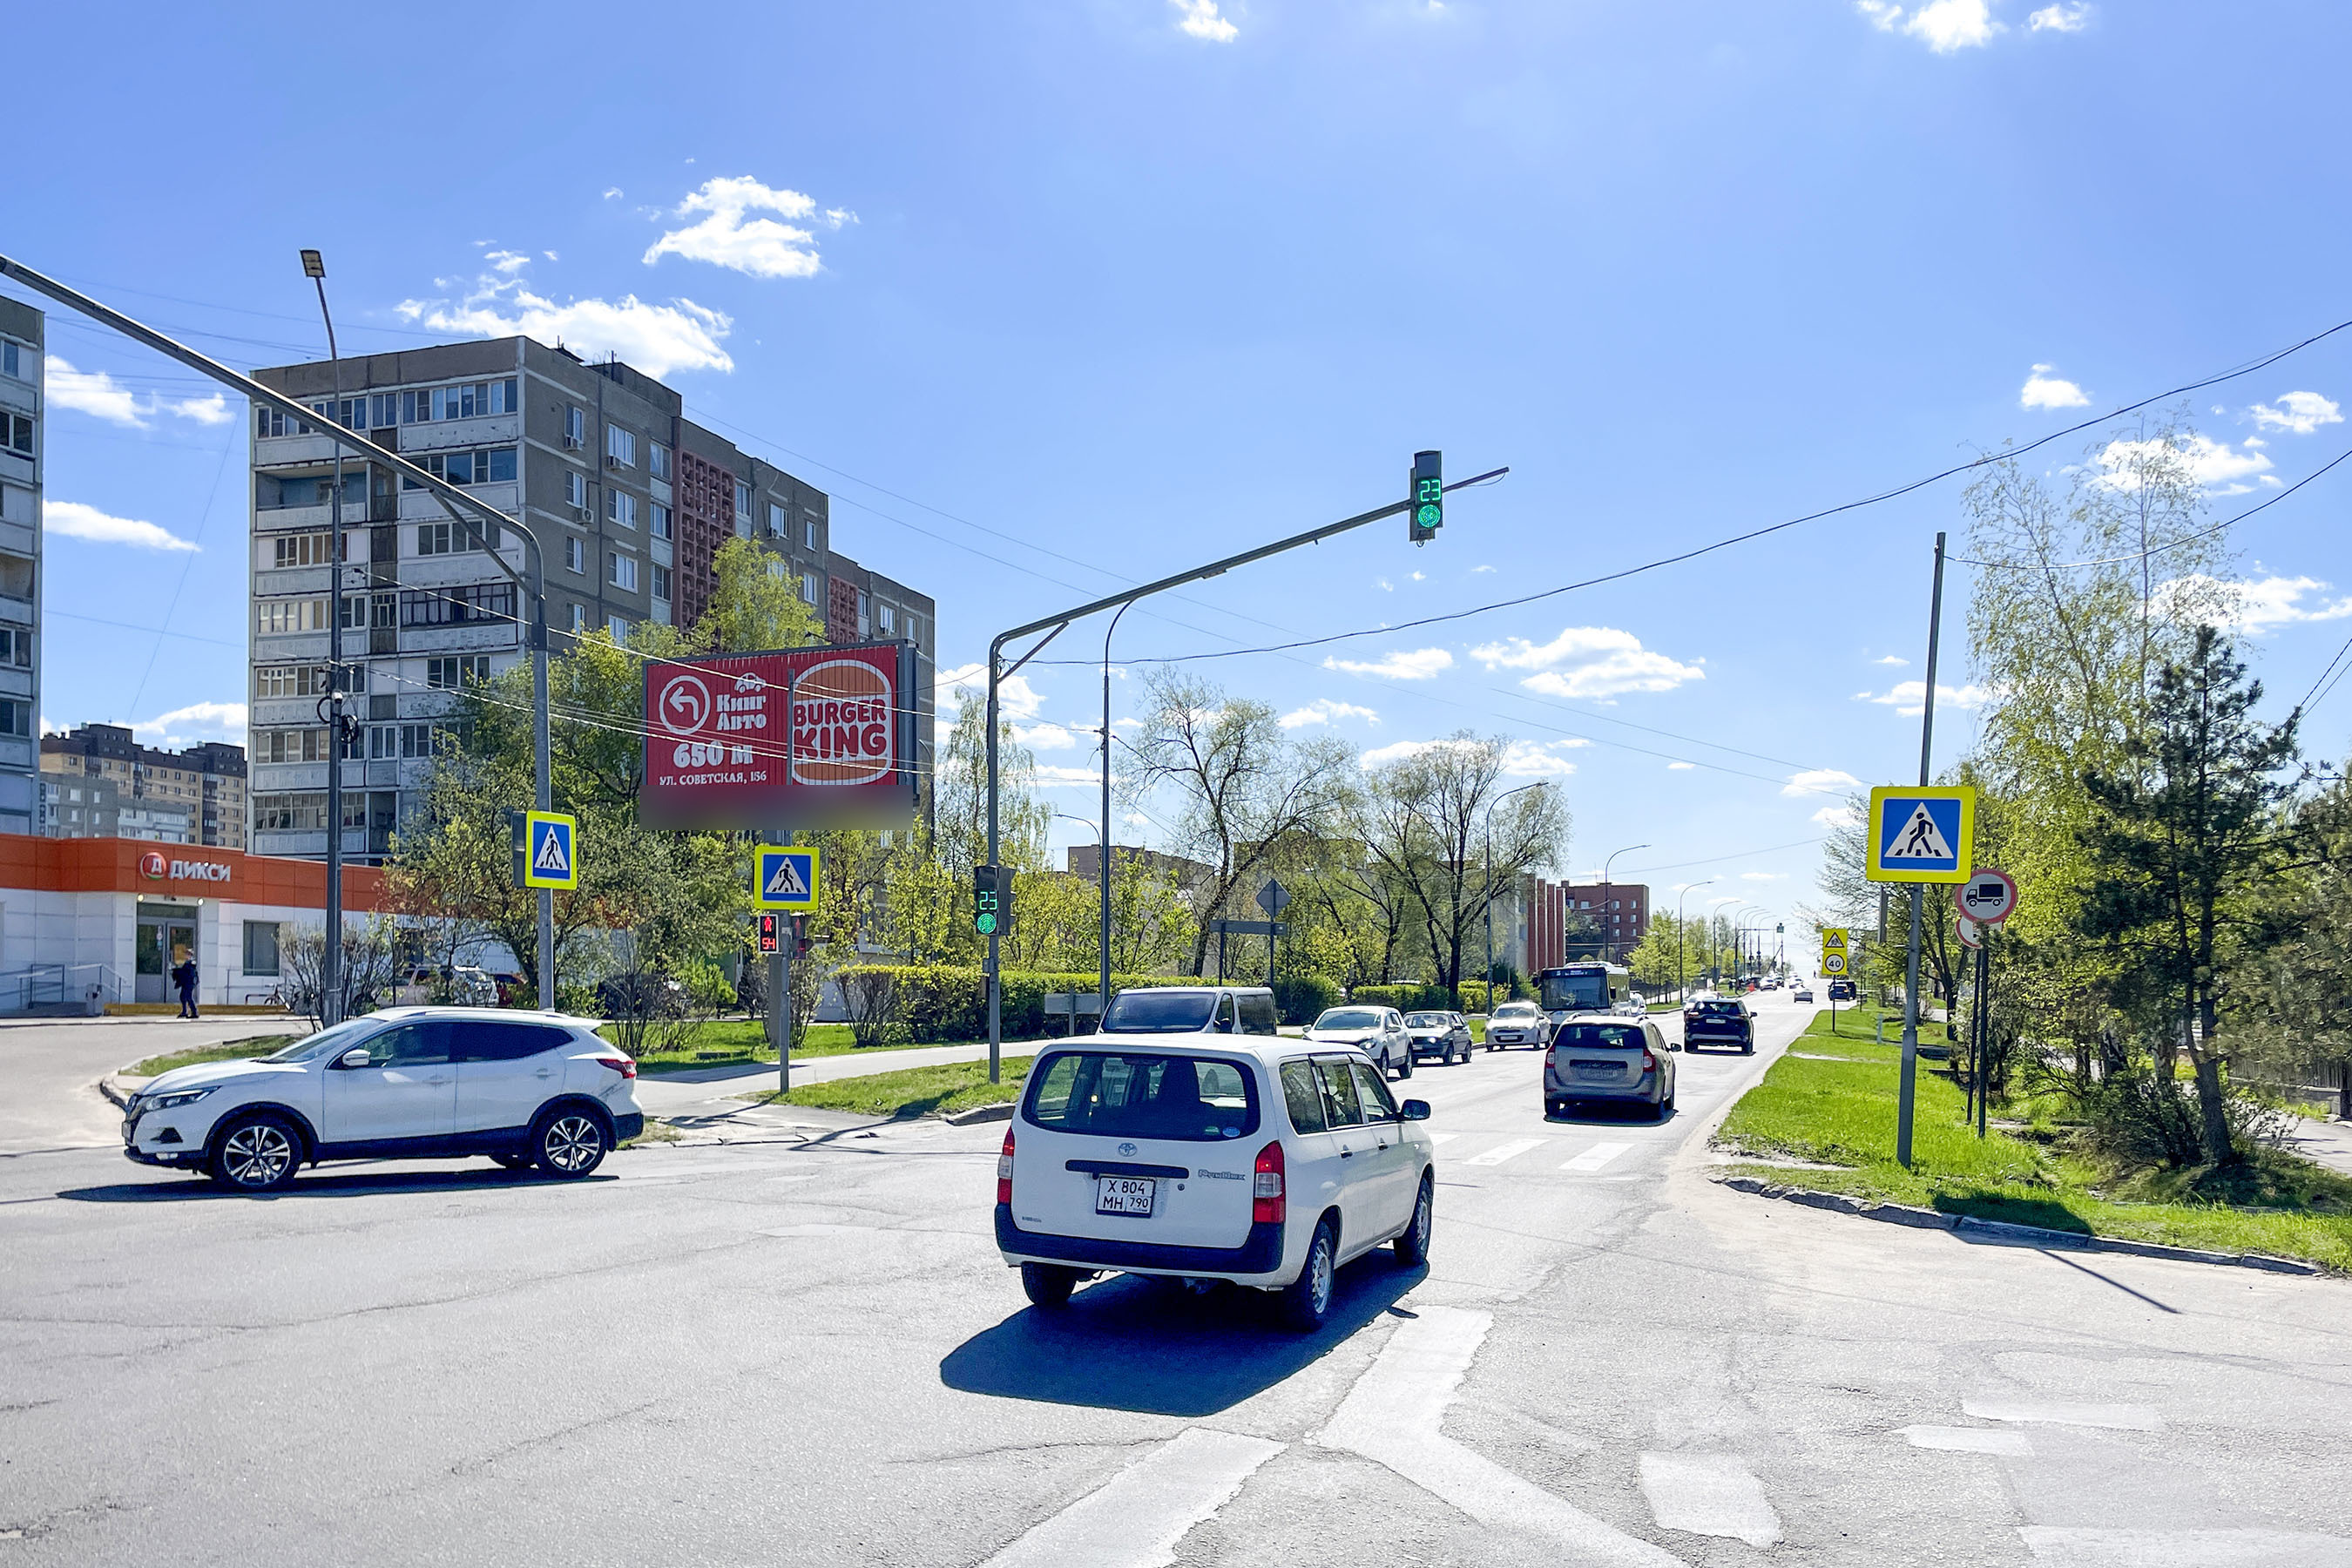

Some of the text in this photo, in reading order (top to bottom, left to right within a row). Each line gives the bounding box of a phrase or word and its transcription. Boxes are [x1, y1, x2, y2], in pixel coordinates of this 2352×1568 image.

[1420, 479, 1442, 503] 23
[716, 694, 767, 712] Кинг
[716, 713, 767, 731] Авто
[794, 699, 887, 727] BURGER
[794, 723, 887, 759] KING
[673, 740, 724, 768] 650
[659, 771, 767, 786] УЛ. СОВЕТСКАЯ, 156
[168, 860, 231, 882] ДИКСИ
[761, 937, 776, 950] 54
[1121, 1181, 1145, 1194] 804
[1130, 1197, 1149, 1208] 790
